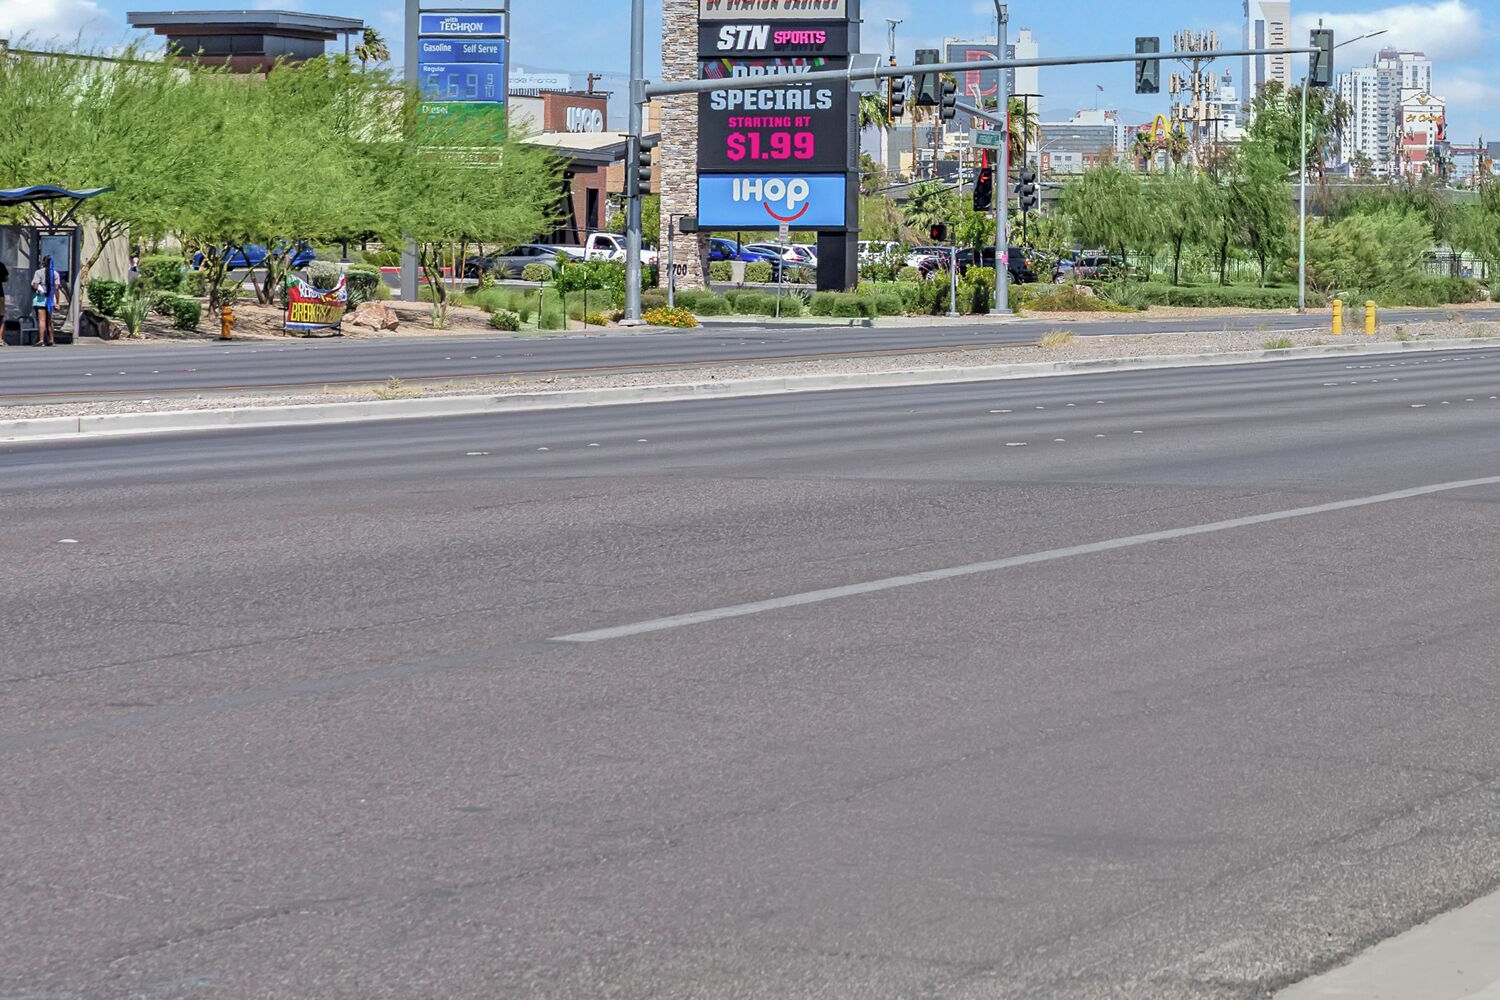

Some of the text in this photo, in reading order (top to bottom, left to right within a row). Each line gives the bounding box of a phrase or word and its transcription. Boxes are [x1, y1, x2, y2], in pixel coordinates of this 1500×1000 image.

[716, 25, 826, 51] STN SPORTS
[423, 43, 498, 53] Gasoline Self Serve
[423, 65, 445, 73] Regular
[710, 89, 832, 110] SPECIALS
[728, 116, 811, 128] STARTING AT
[726, 132, 815, 161] $1.99
[666, 264, 688, 276] 700
